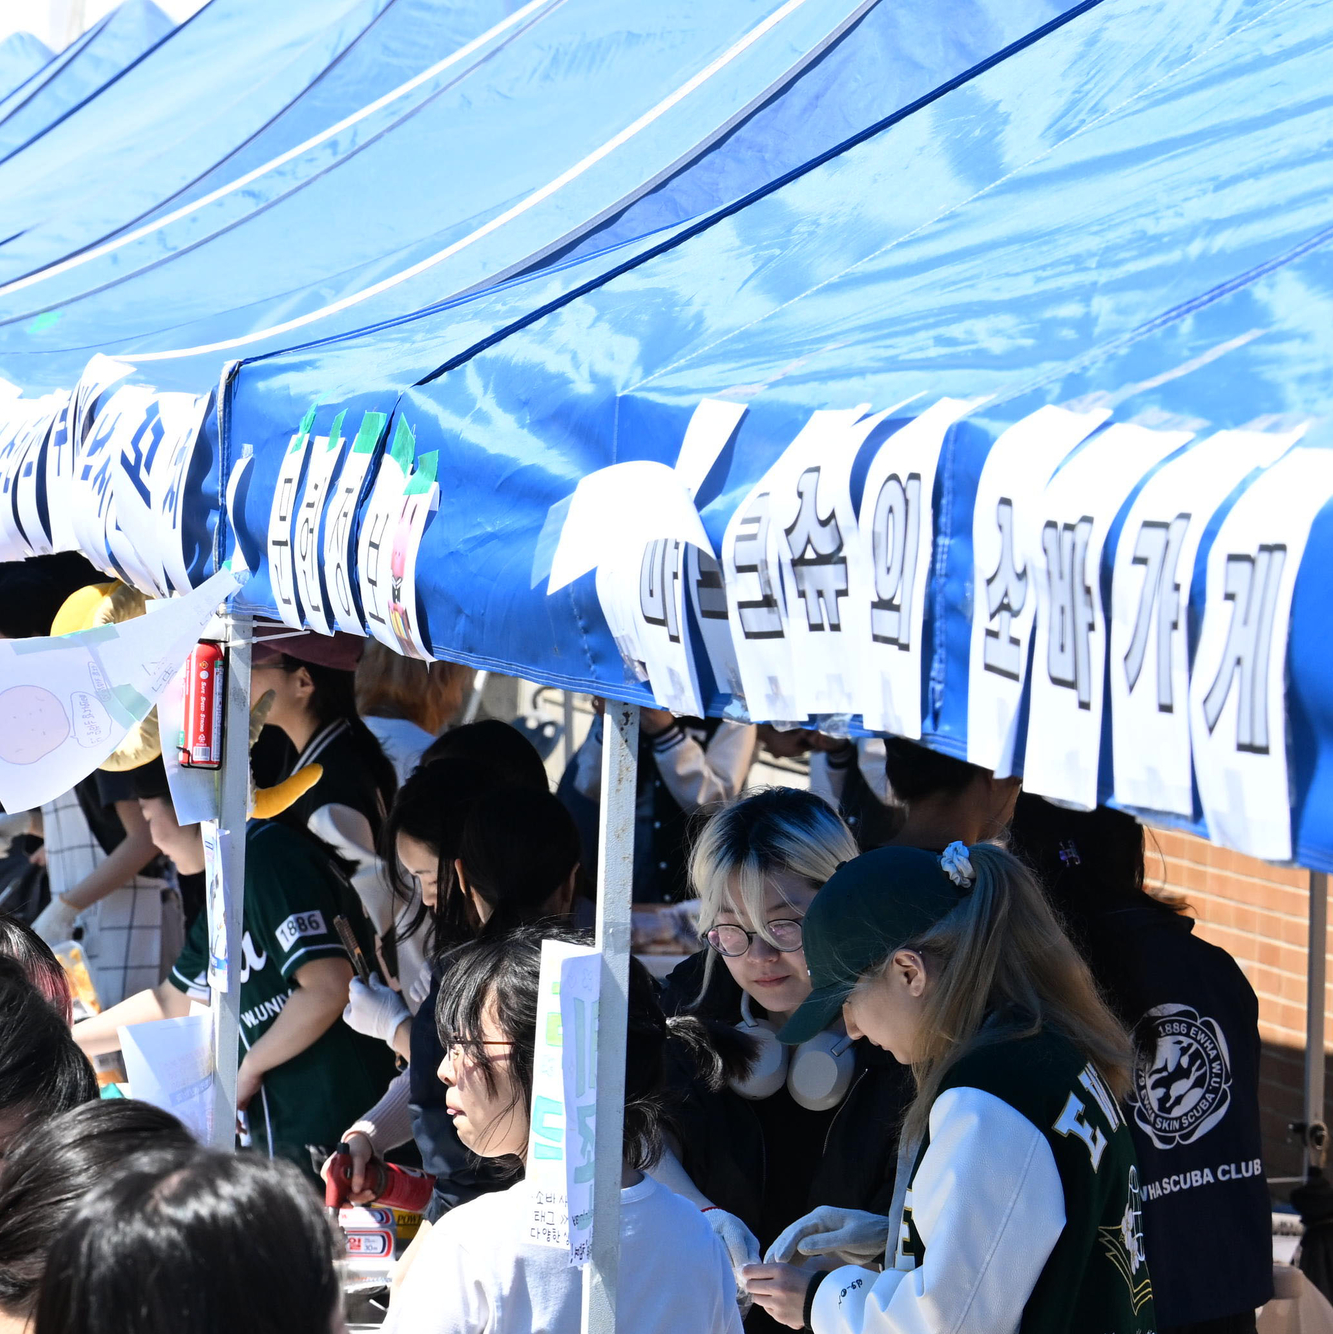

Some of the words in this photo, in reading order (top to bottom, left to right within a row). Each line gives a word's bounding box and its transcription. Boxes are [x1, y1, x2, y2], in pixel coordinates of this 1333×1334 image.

[984, 496, 1287, 755] 소바가게
[280, 913, 320, 942] 1886
[1157, 1022, 1187, 1037] 1886
[1190, 1027, 1218, 1059] EWHA
[1155, 1118, 1181, 1131] SKIN
[1182, 1093, 1216, 1127] SCUBA
[1217, 1158, 1262, 1182] CLUB
[536, 1190, 556, 1204] 소바
[533, 1210, 555, 1226] 태그
[530, 1227, 561, 1244] 다양한
